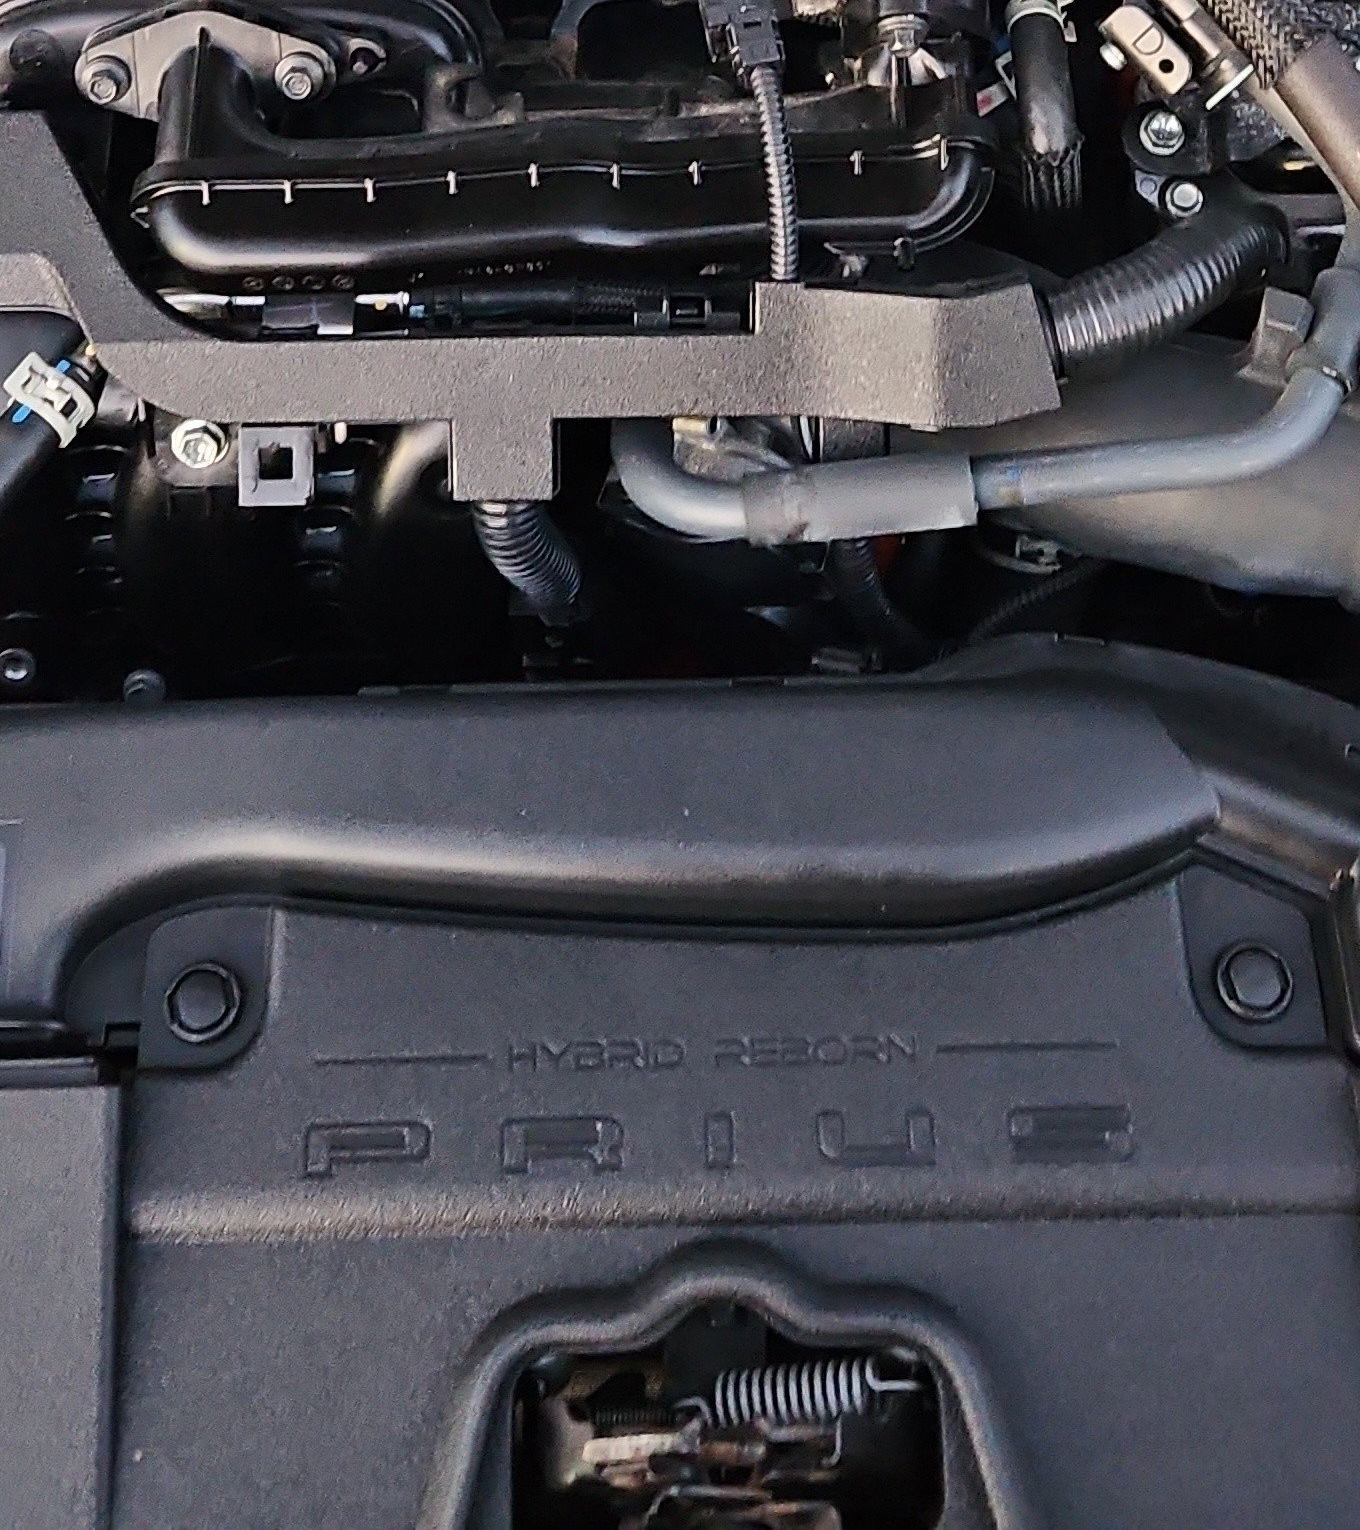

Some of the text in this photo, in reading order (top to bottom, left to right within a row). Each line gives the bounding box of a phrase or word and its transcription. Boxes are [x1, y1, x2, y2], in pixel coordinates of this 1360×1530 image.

[506, 1034, 918, 1072] HYBRID REBORN
[301, 1102, 1136, 1178] PRIUS
